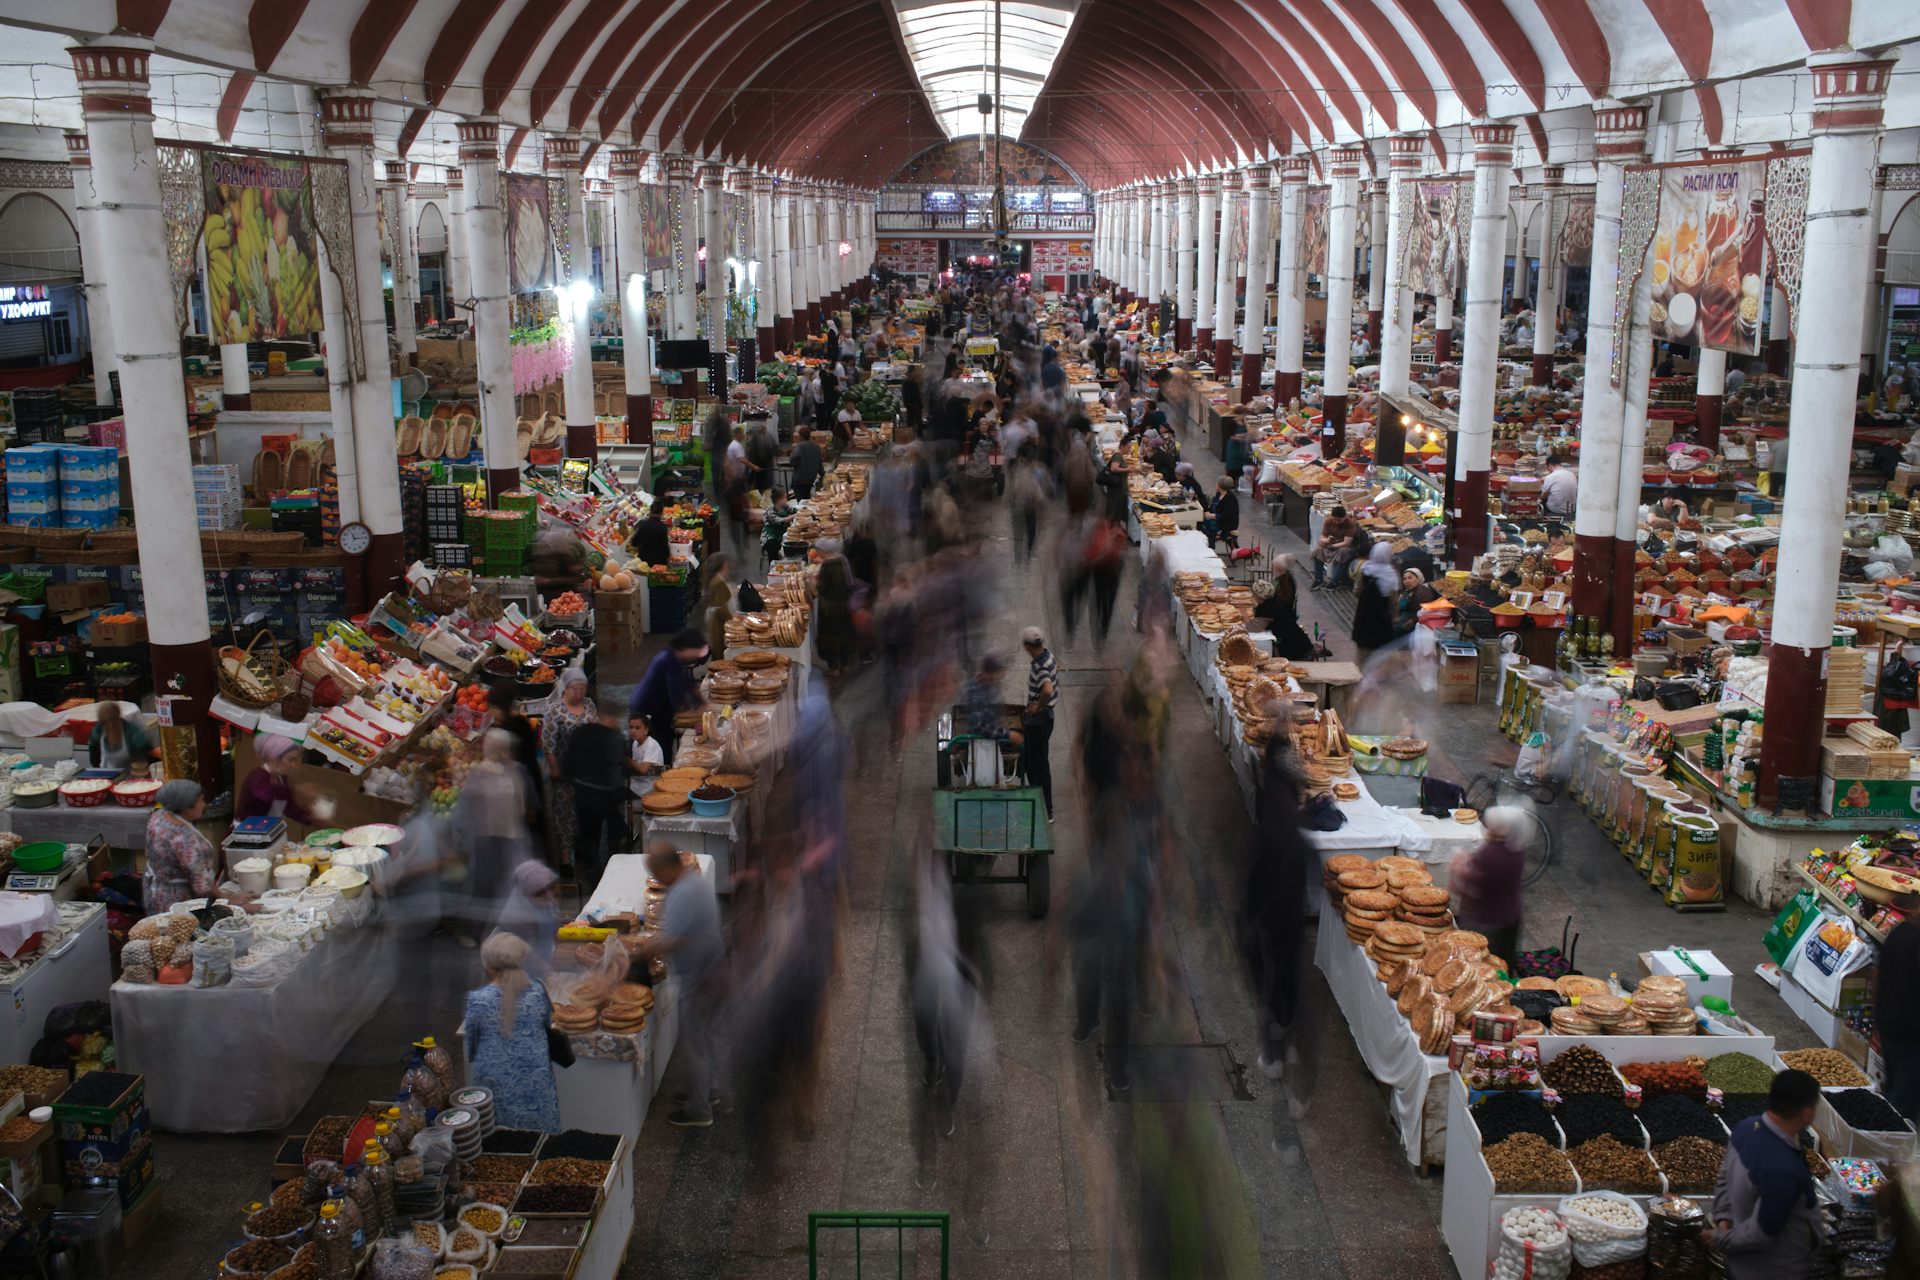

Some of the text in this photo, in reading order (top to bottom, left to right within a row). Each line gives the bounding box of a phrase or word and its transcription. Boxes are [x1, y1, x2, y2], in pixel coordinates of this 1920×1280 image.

[22, 568, 53, 577] Banaval
[77, 568, 108, 578] Banaval
[251, 594, 281, 603] Banaval
[307, 593, 337, 602] Banaval
[1688, 851, 1718, 863] ЗИРА
[87, 1134, 109, 1142] MERS
